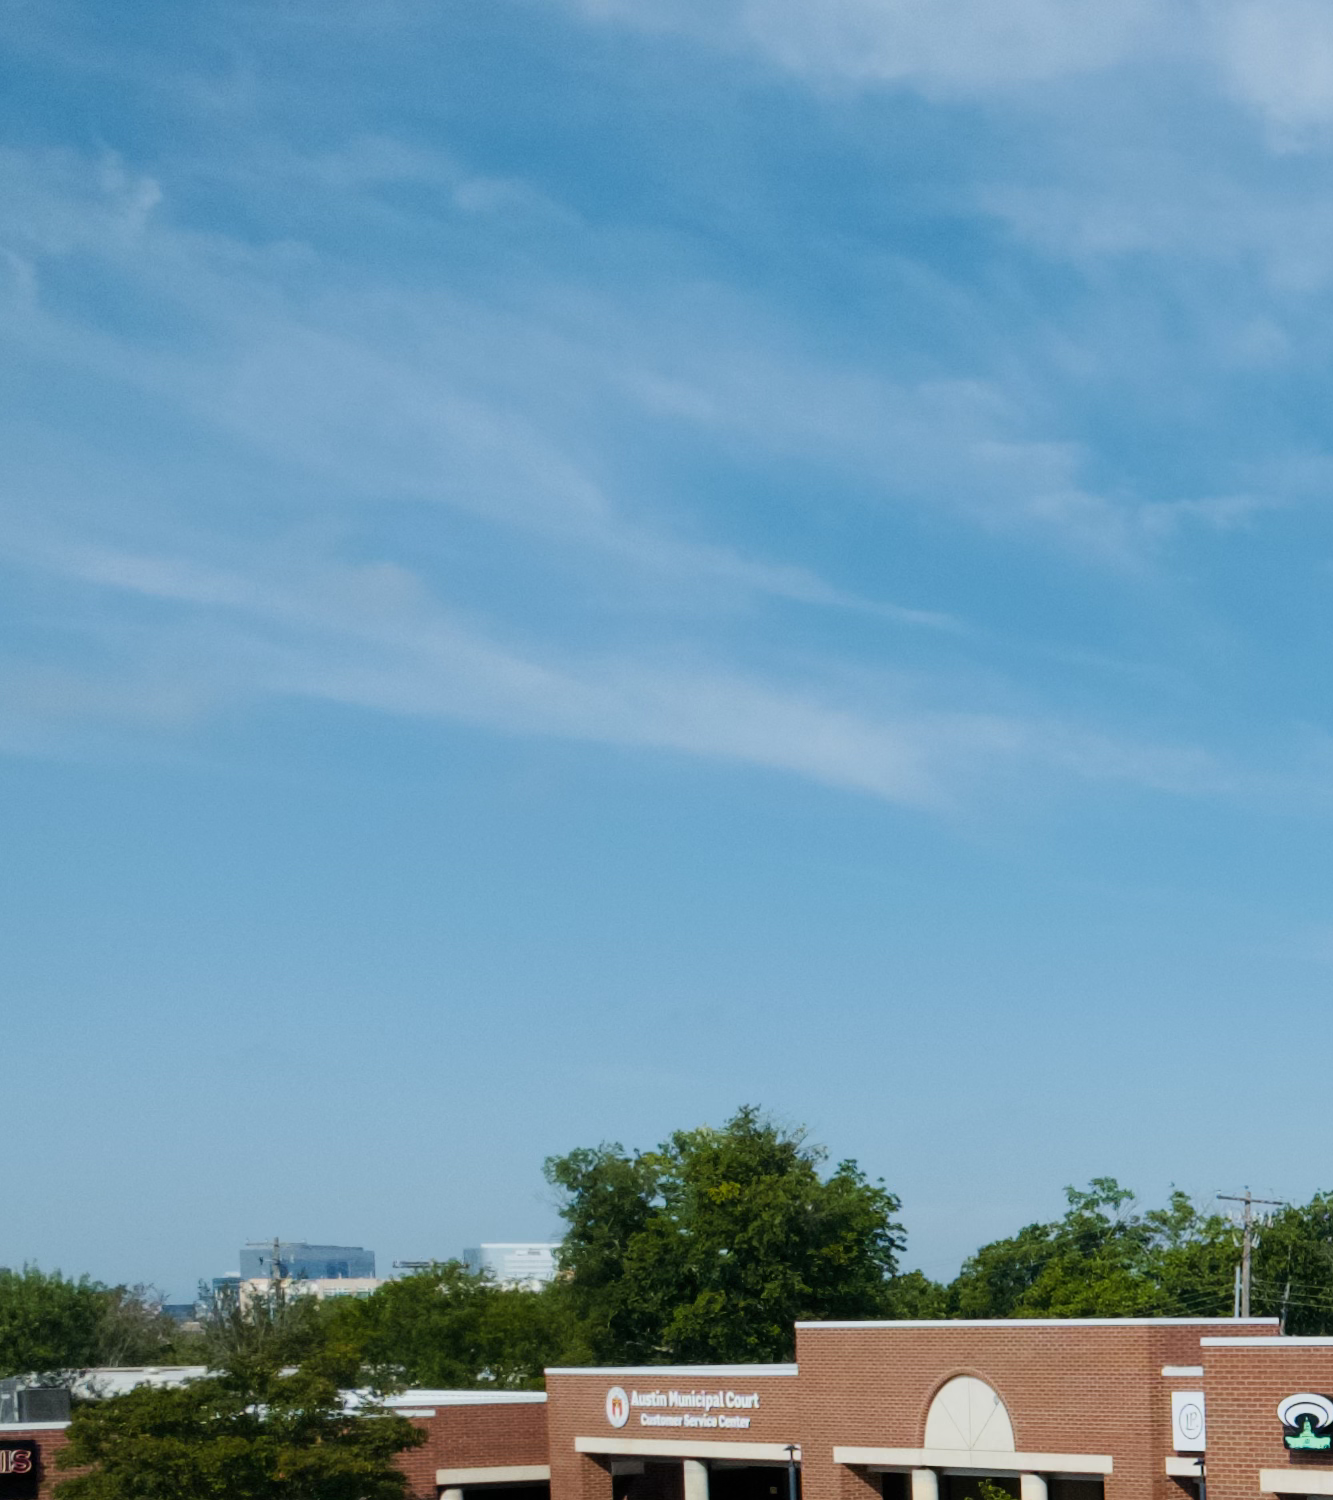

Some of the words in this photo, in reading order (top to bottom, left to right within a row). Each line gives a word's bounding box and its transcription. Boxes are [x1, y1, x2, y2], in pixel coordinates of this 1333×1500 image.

[631, 1391, 667, 1407] Austin
[668, 1390, 724, 1411] Municipal
[725, 1392, 760, 1409] Court
[640, 1413, 683, 1427] Customer
[684, 1414, 718, 1428] Service
[718, 1415, 750, 1429] Center
